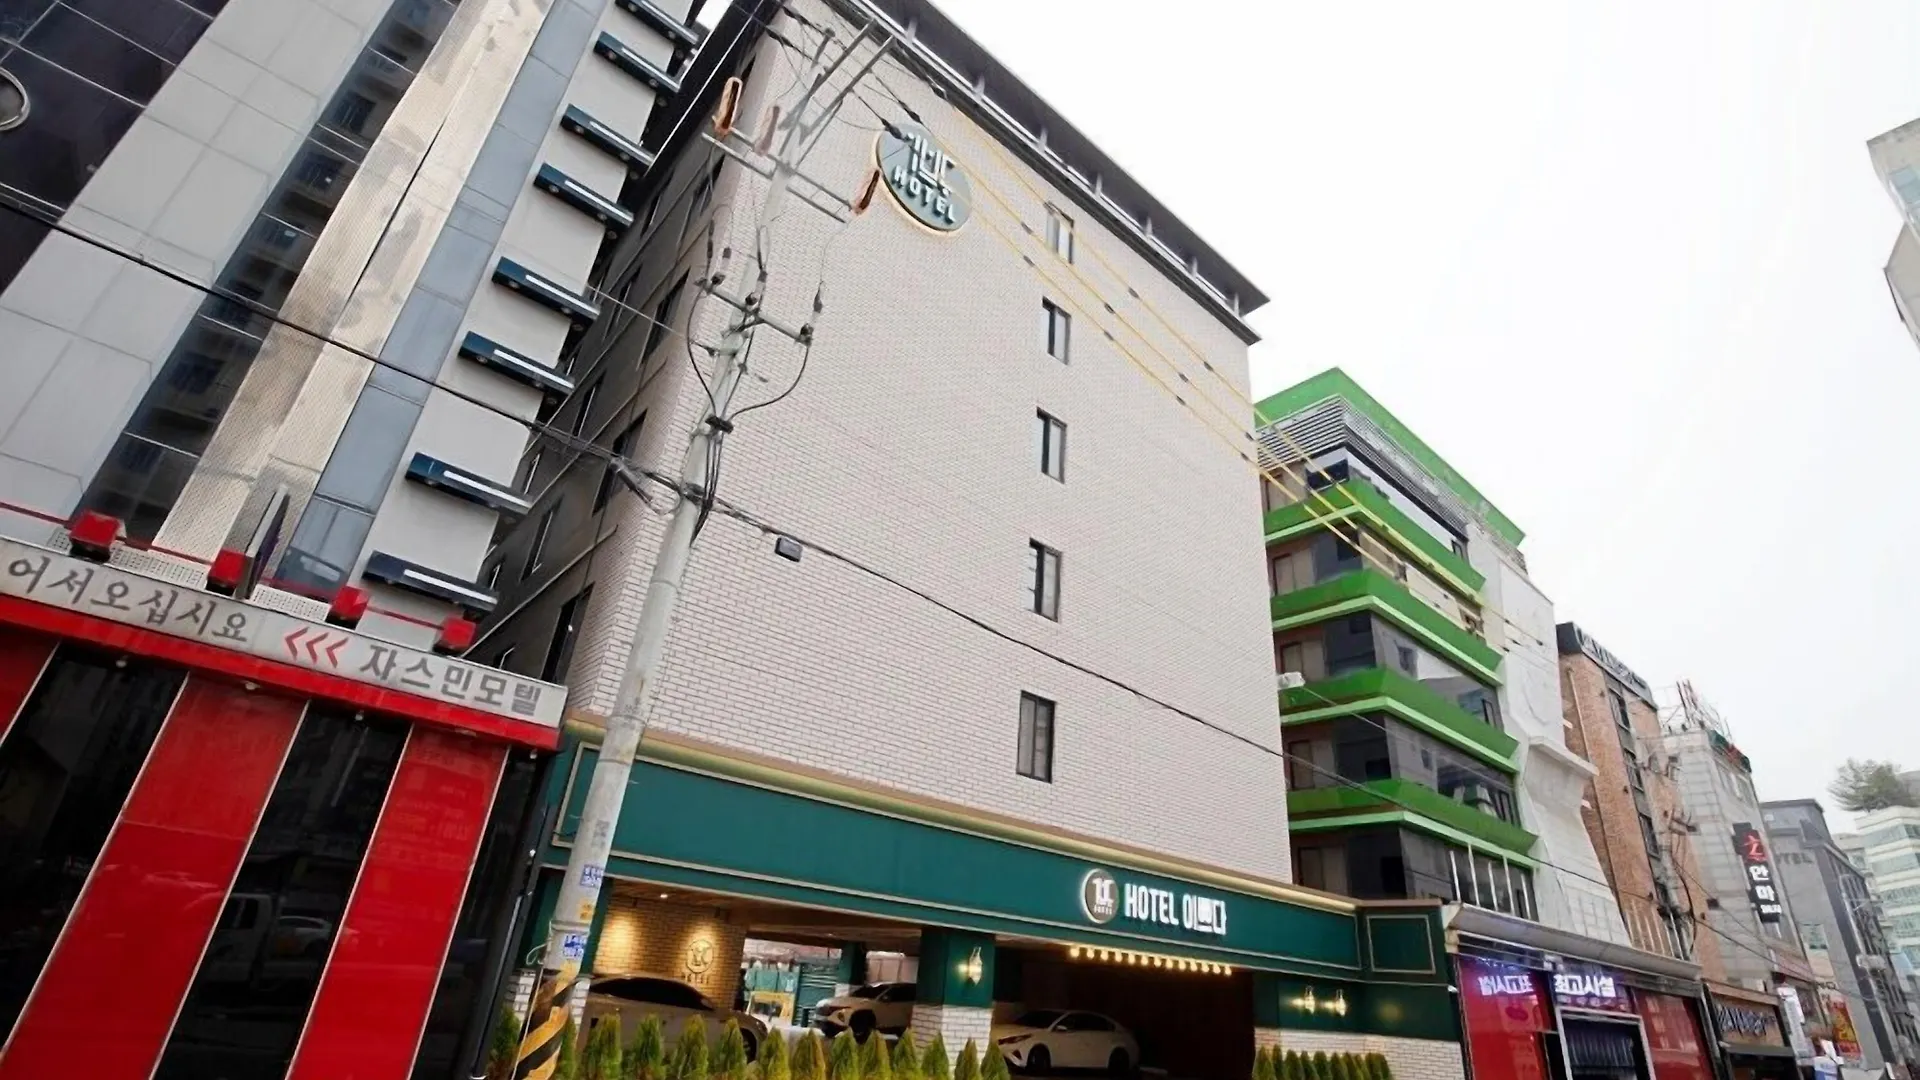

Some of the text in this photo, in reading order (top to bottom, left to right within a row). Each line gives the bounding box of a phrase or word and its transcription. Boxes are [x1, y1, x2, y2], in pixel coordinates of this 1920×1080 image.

[894, 166, 956, 223] HOTEL
[8, 556, 248, 643] 어서오십시요
[359, 644, 542, 716] 자스민모텔
[1125, 884, 1180, 926] HOTEL
[1553, 973, 1617, 998] 최고시설
